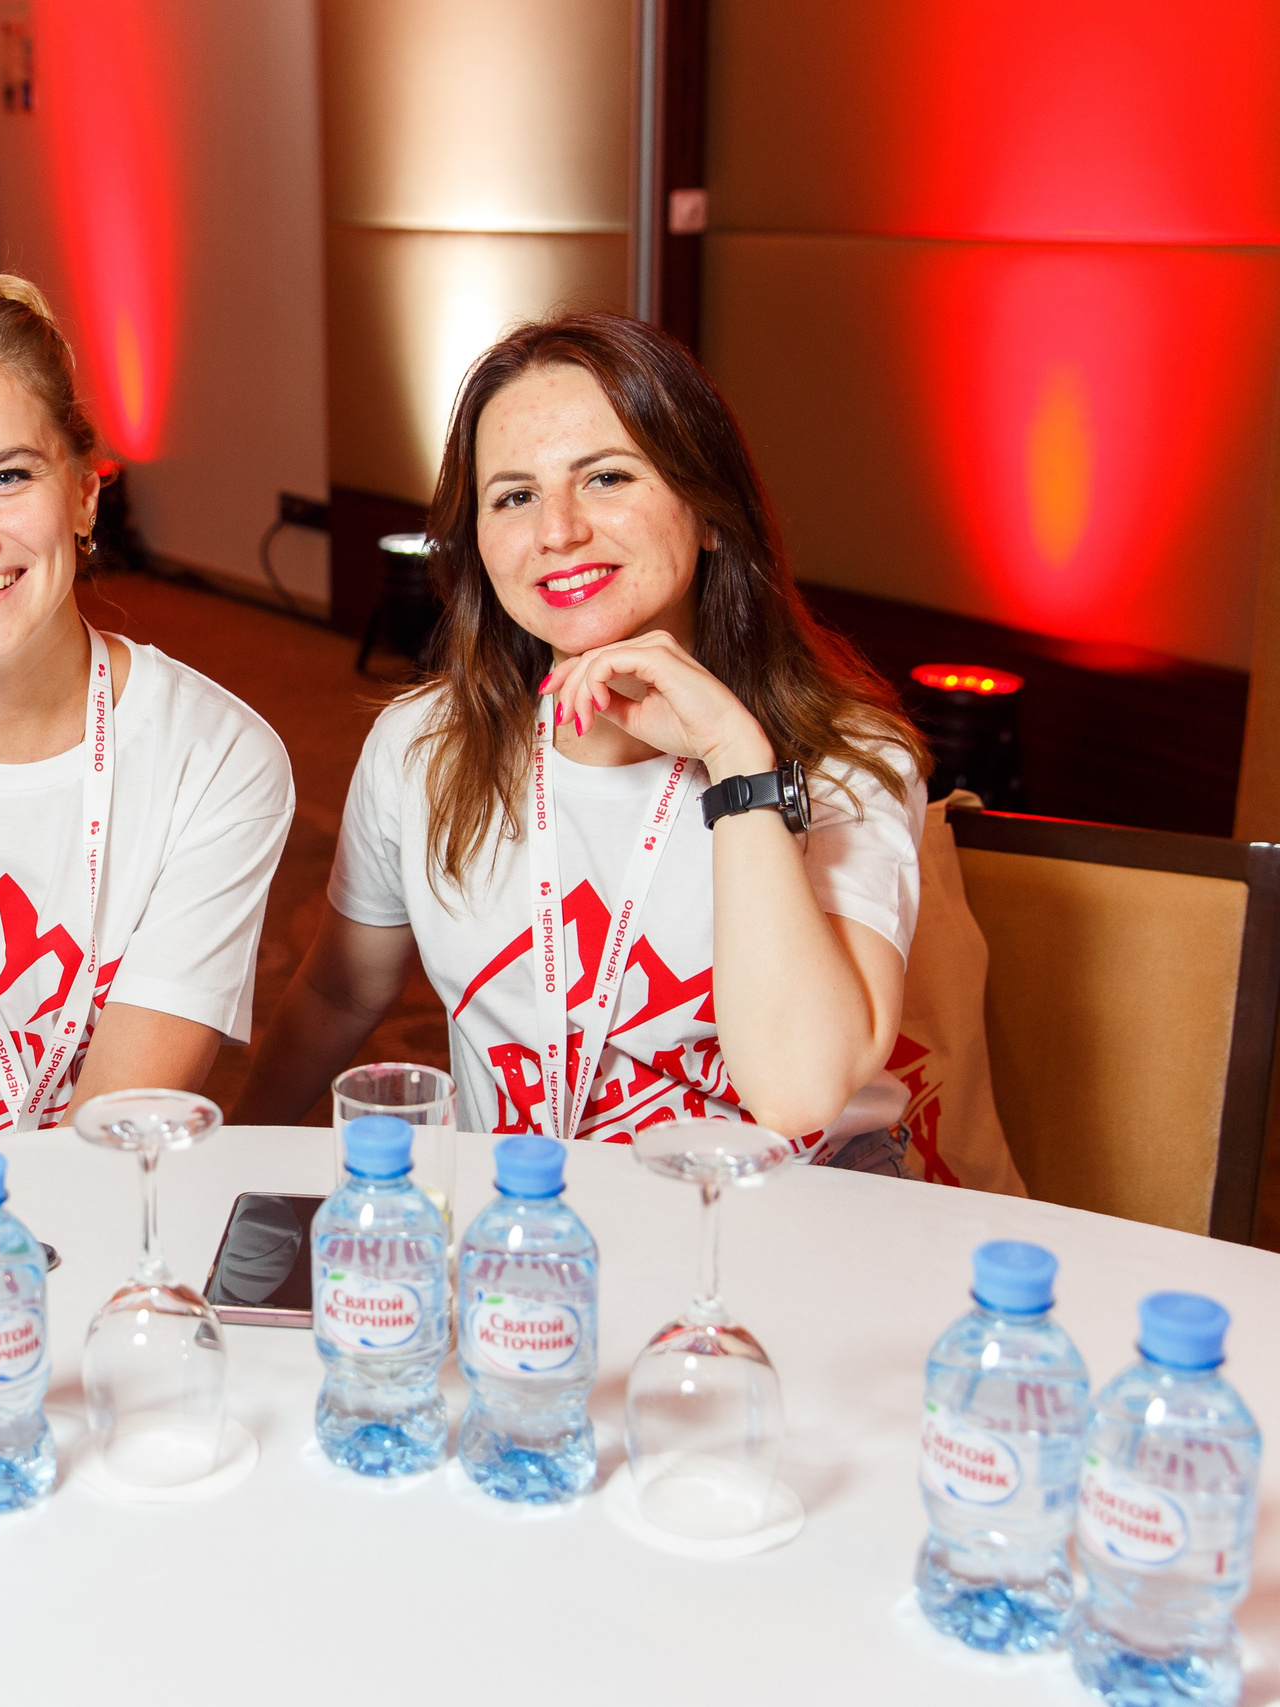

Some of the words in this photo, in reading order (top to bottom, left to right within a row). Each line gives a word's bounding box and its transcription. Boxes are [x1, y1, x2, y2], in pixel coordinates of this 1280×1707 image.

[94, 691, 106, 773] ЧЕРКИЗОВО
[535, 747, 547, 831] ЧЕРКИЗОВО
[653, 756, 688, 824] ЧЕРКИЗОВ
[542, 909, 556, 993] ЧЕРКИЗОВО
[605, 900, 634, 982] ЧЕРКИЗОВО
[28, 1045, 67, 1114] ЧЕРКИЗОВО
[550, 1071, 560, 1139] ЧЕРКИЗО
[324, 1301, 416, 1328] Источник
[479, 1325, 575, 1351] Источник
